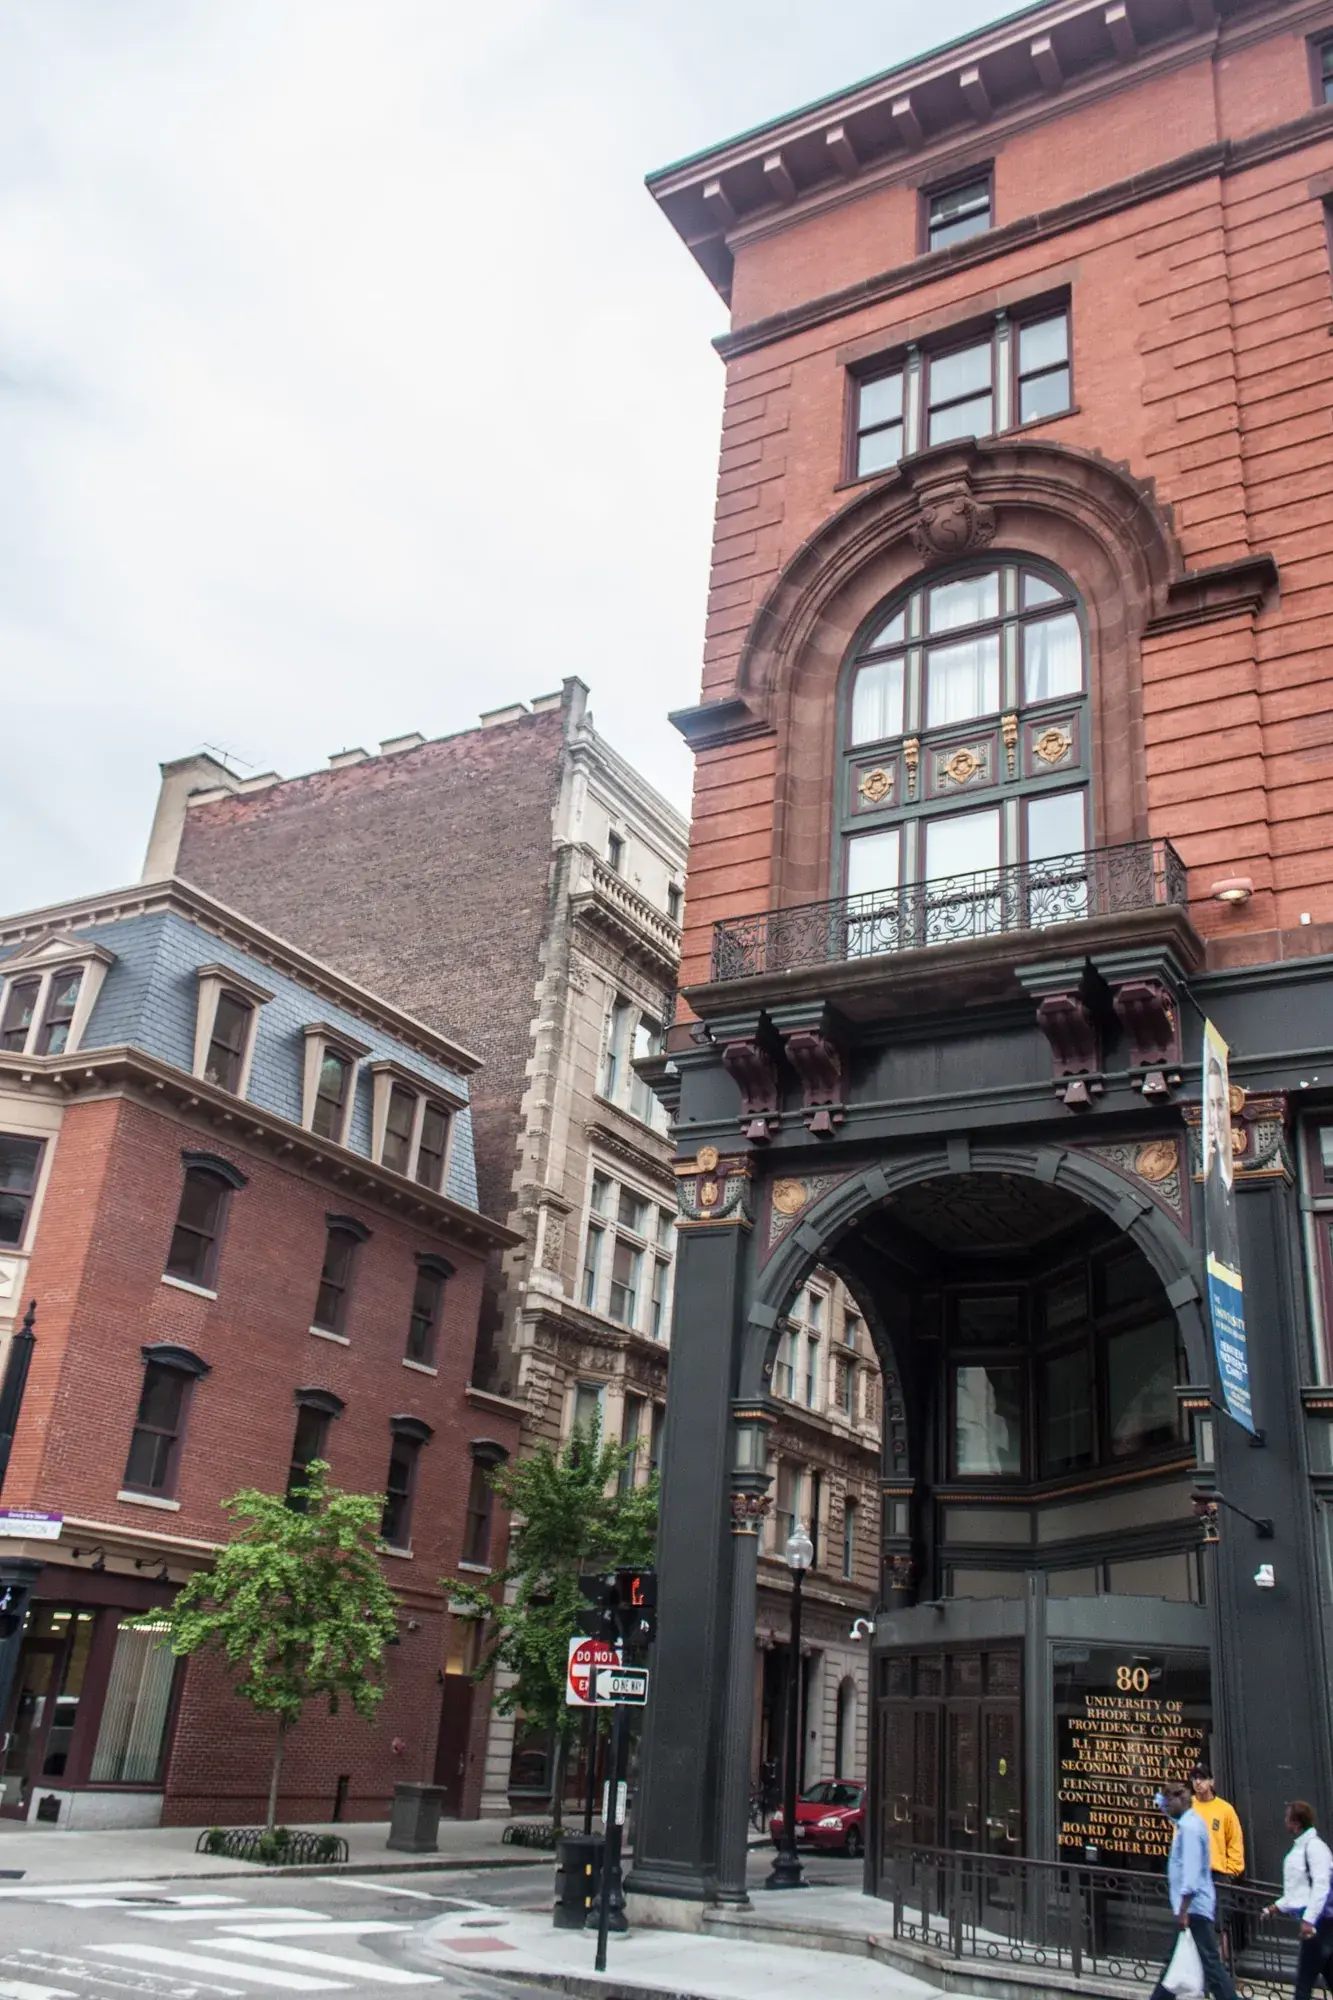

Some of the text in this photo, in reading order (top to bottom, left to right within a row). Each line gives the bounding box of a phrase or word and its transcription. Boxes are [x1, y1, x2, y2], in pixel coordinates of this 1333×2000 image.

[577, 1651, 612, 1663] DO NOT
[612, 1679, 642, 1692] ONE WAY
[1116, 1665, 1150, 1692] 80
[1085, 1695, 1184, 1712] UNIVERSITY OF
[1087, 1708, 1182, 1724] RHODE ISLAND
[1068, 1719, 1203, 1739] PROVIDENCE CAMPUS
[1072, 1737, 1201, 1758] R.I. DEPARTMENT OF
[1079, 1749, 1195, 1769] ELEMENTARY AND
[1061, 1760, 1190, 1781] SECONDARY EDUCAT
[1063, 1778, 1128, 1793] FEINSTEIN
[1058, 1790, 1139, 1808] CONTINUING
[1090, 1811, 1177, 1829] RHODE ISLAN
[1063, 1822, 1106, 1836] BOARD
[1112, 1827, 1130, 1839] OF
[1058, 1834, 1083, 1847] FOR
